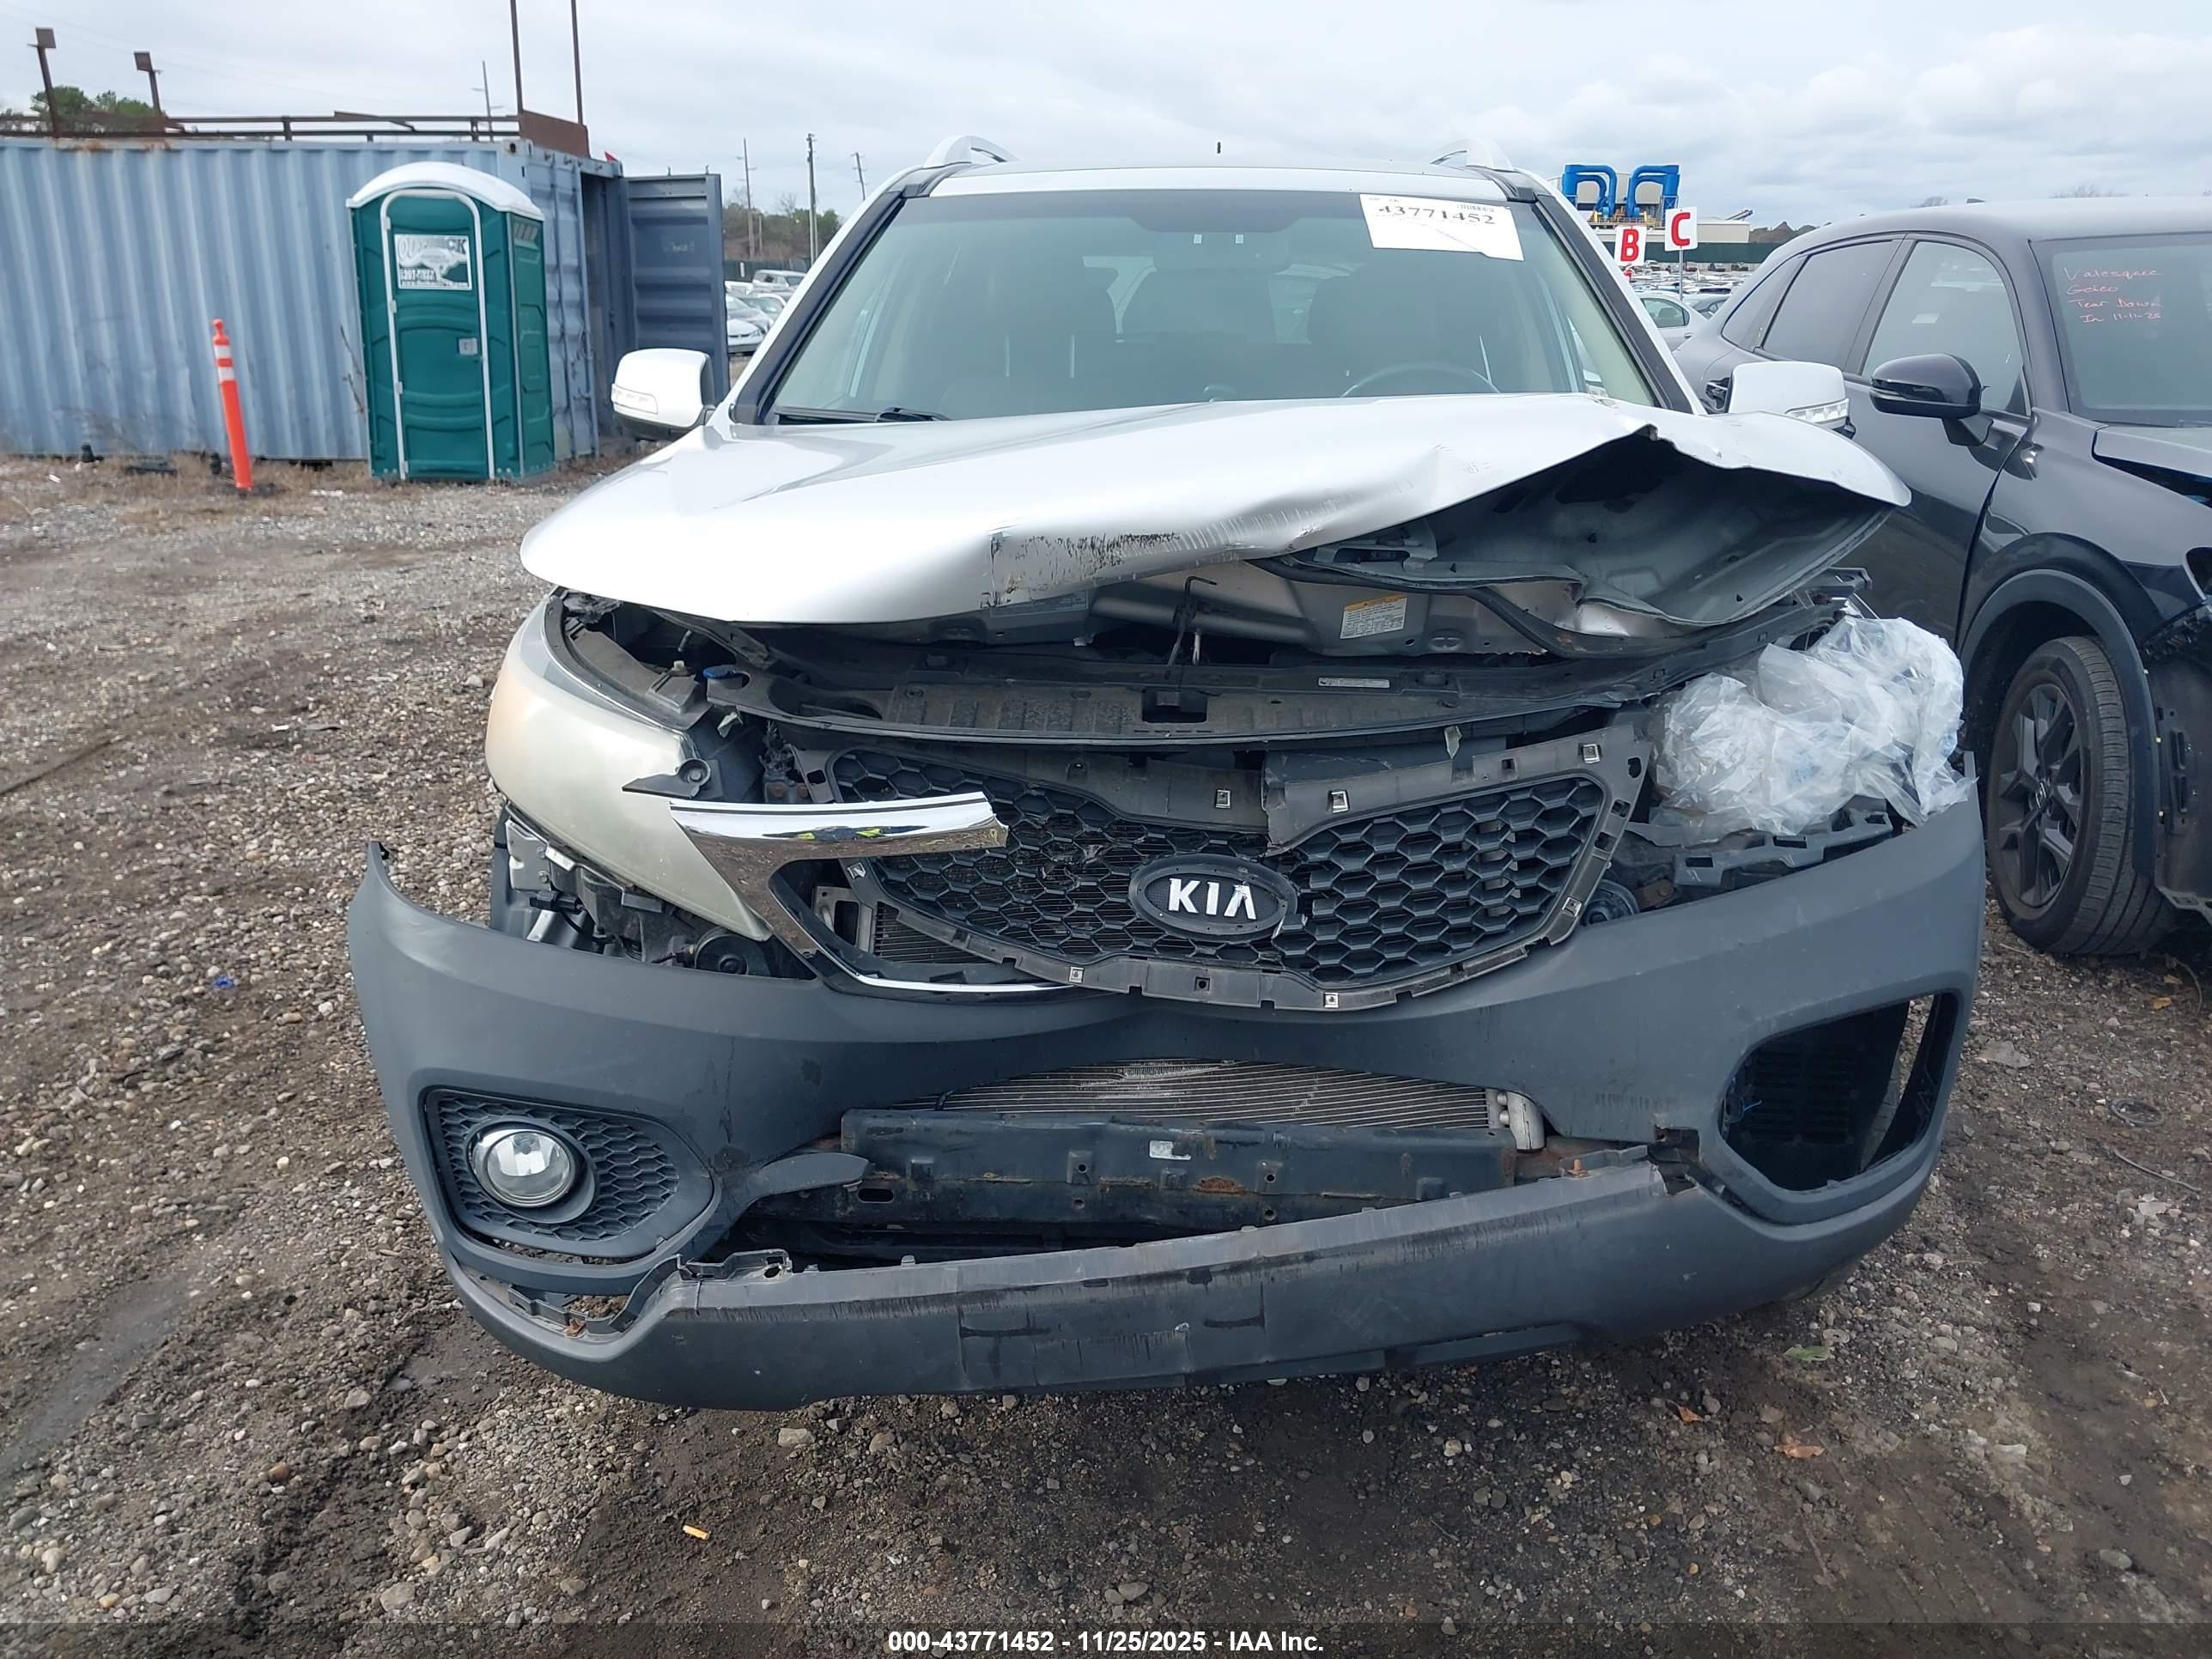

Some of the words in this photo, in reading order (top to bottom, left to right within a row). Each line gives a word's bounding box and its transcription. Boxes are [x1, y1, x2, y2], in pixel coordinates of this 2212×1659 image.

[1378, 205, 1496, 225] 43771452
[1671, 211, 1691, 246] C
[1620, 228, 1639, 262] B
[1168, 878, 1257, 920] KIA
